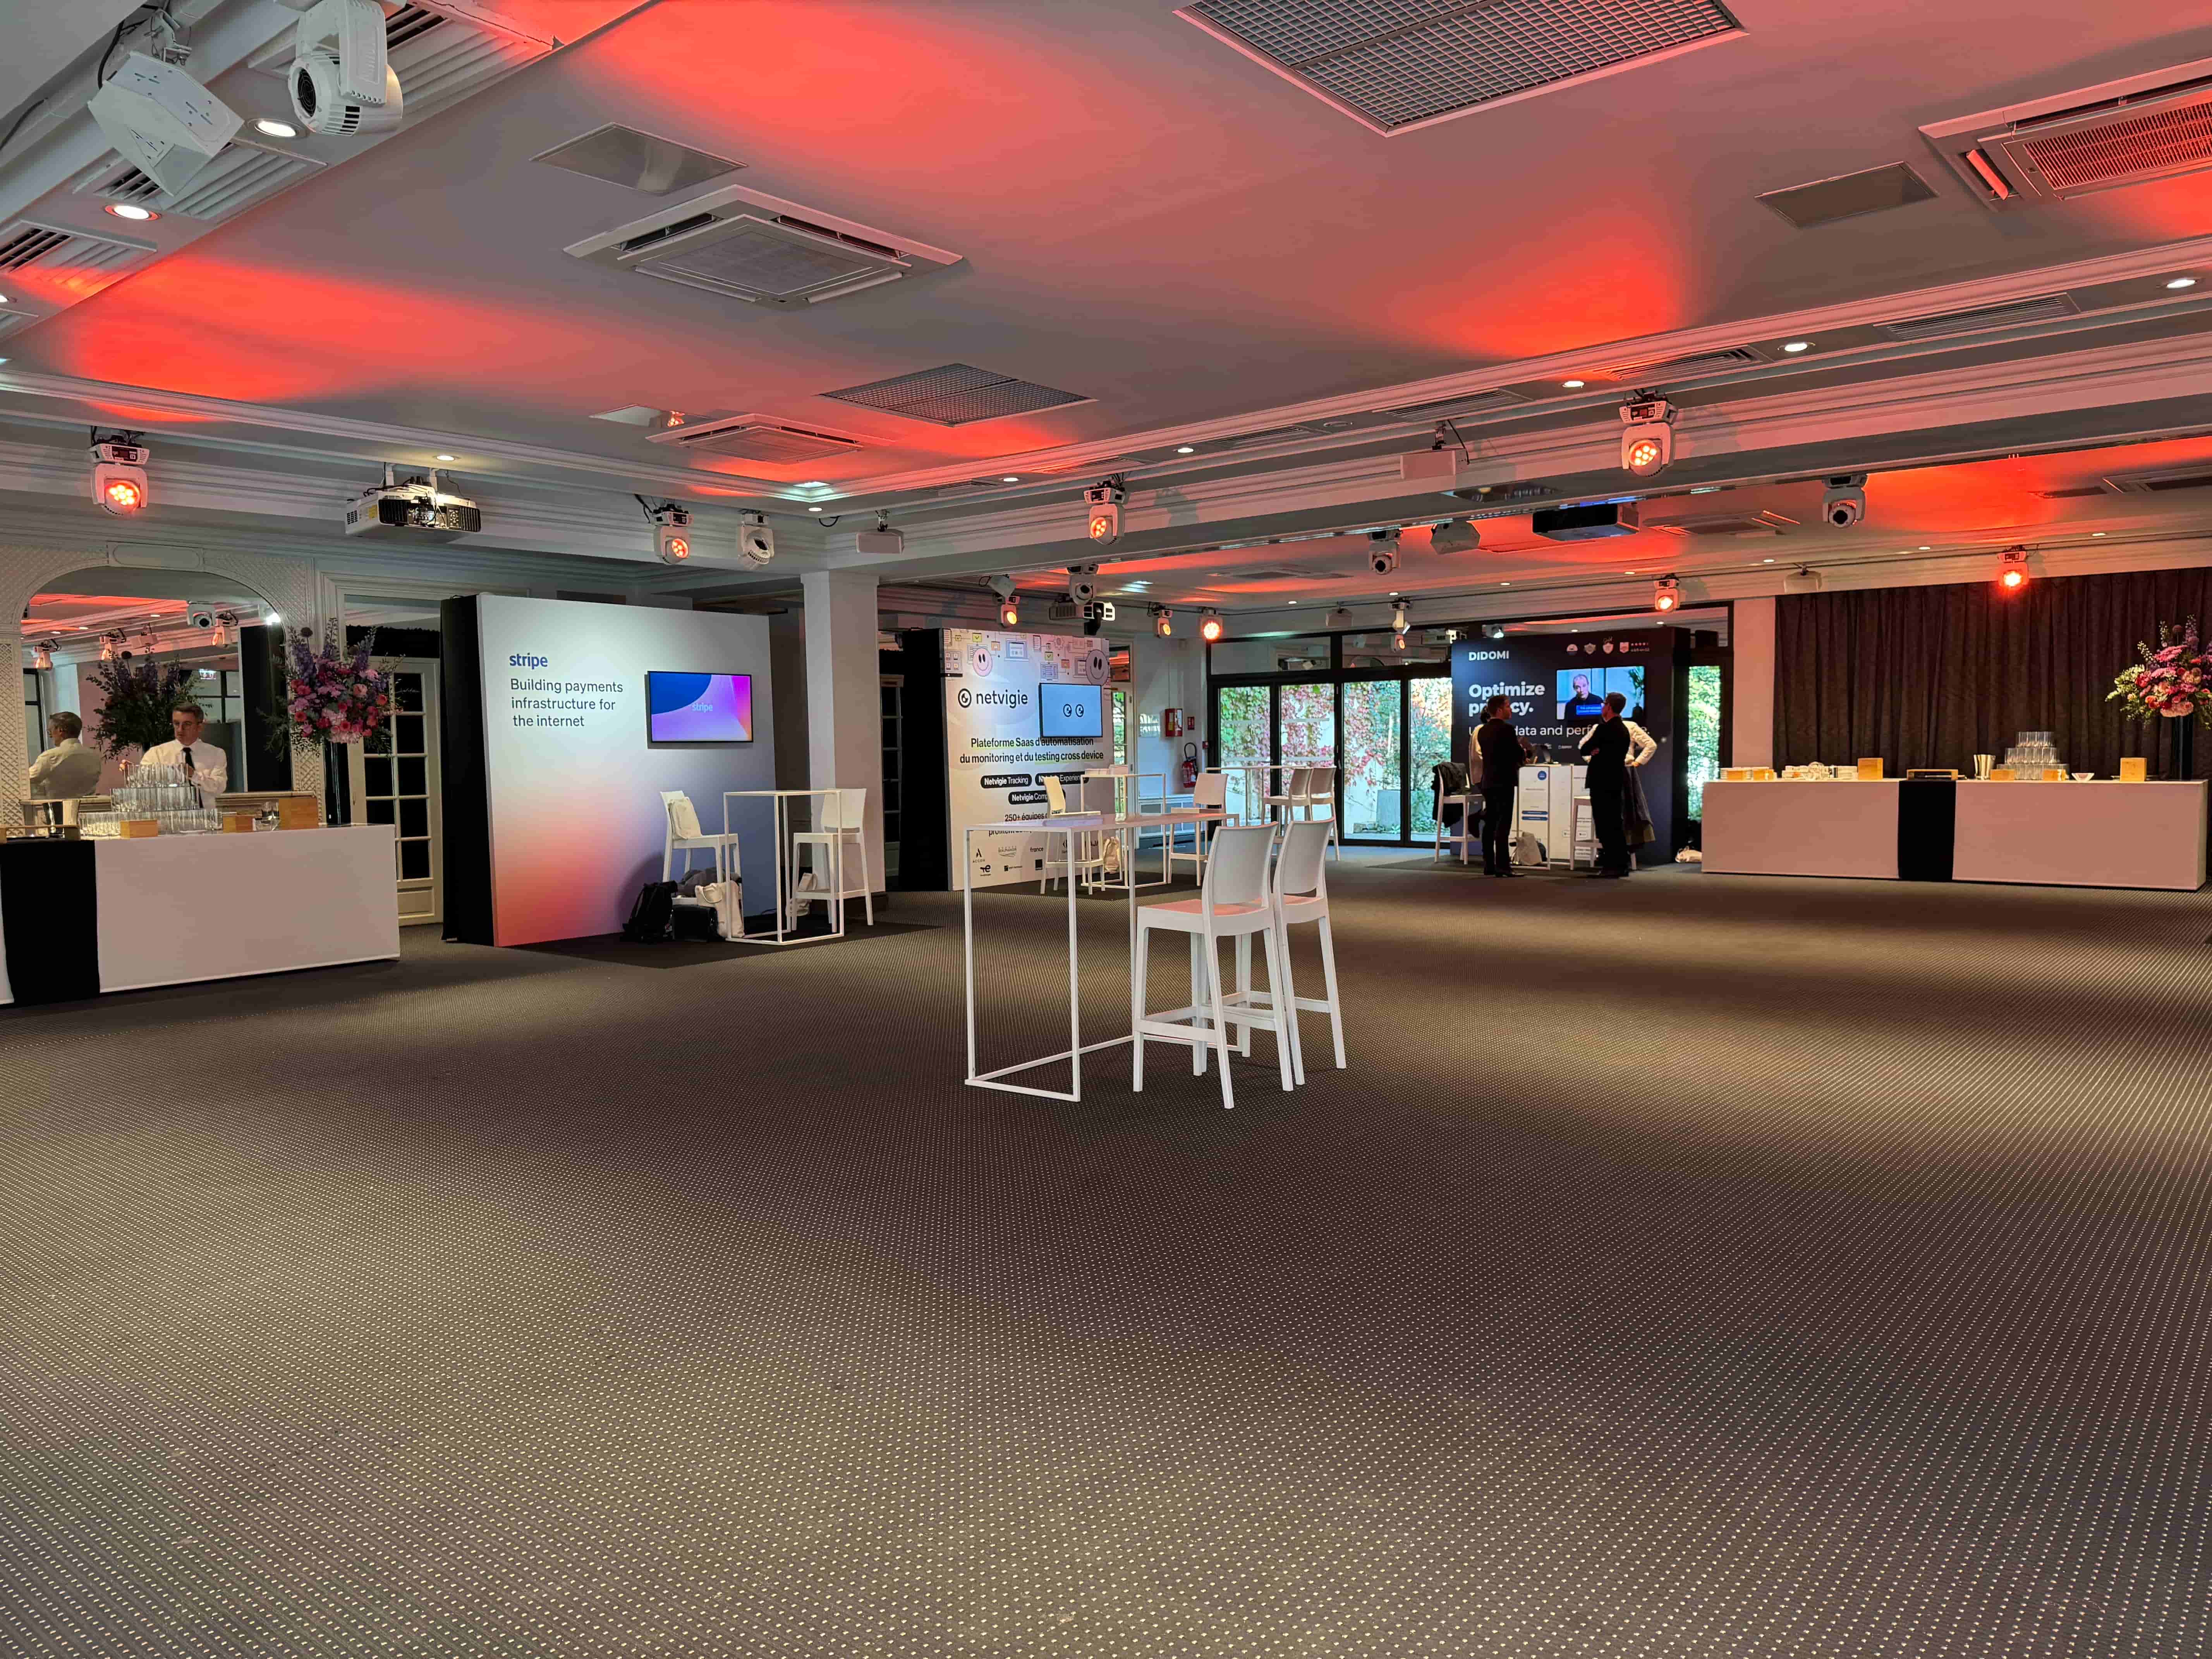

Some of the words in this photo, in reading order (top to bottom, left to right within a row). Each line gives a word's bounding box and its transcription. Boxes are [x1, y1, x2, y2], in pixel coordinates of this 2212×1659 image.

[509, 653, 548, 669] stripe
[1468, 651, 1509, 661] DIDOMI
[511, 678, 561, 693] Building
[565, 682, 623, 694] payments
[1468, 681, 1545, 700] Optimize
[512, 697, 595, 709] infrastructure
[599, 699, 615, 710] for
[976, 689, 1028, 708] netvigie
[1469, 700, 1534, 717] prcy.
[513, 715, 533, 726] the
[537, 715, 584, 726] internet
[1540, 725, 1563, 736] and
[971, 738, 1014, 748] Plateforme
[1016, 737, 1034, 747] Saas
[960, 754, 970, 763] du
[972, 753, 1014, 764] monitoring
[1016, 752, 1023, 761] et
[1024, 752, 1034, 761] du
[1035, 751, 1060, 762] testing
[1081, 750, 1103, 759] device
[984, 777, 1007, 786] Netvigie
[1007, 776, 1029, 785] Tracking
[1012, 793, 1034, 802] Netvigie
[1005, 813, 1020, 822] 250+
